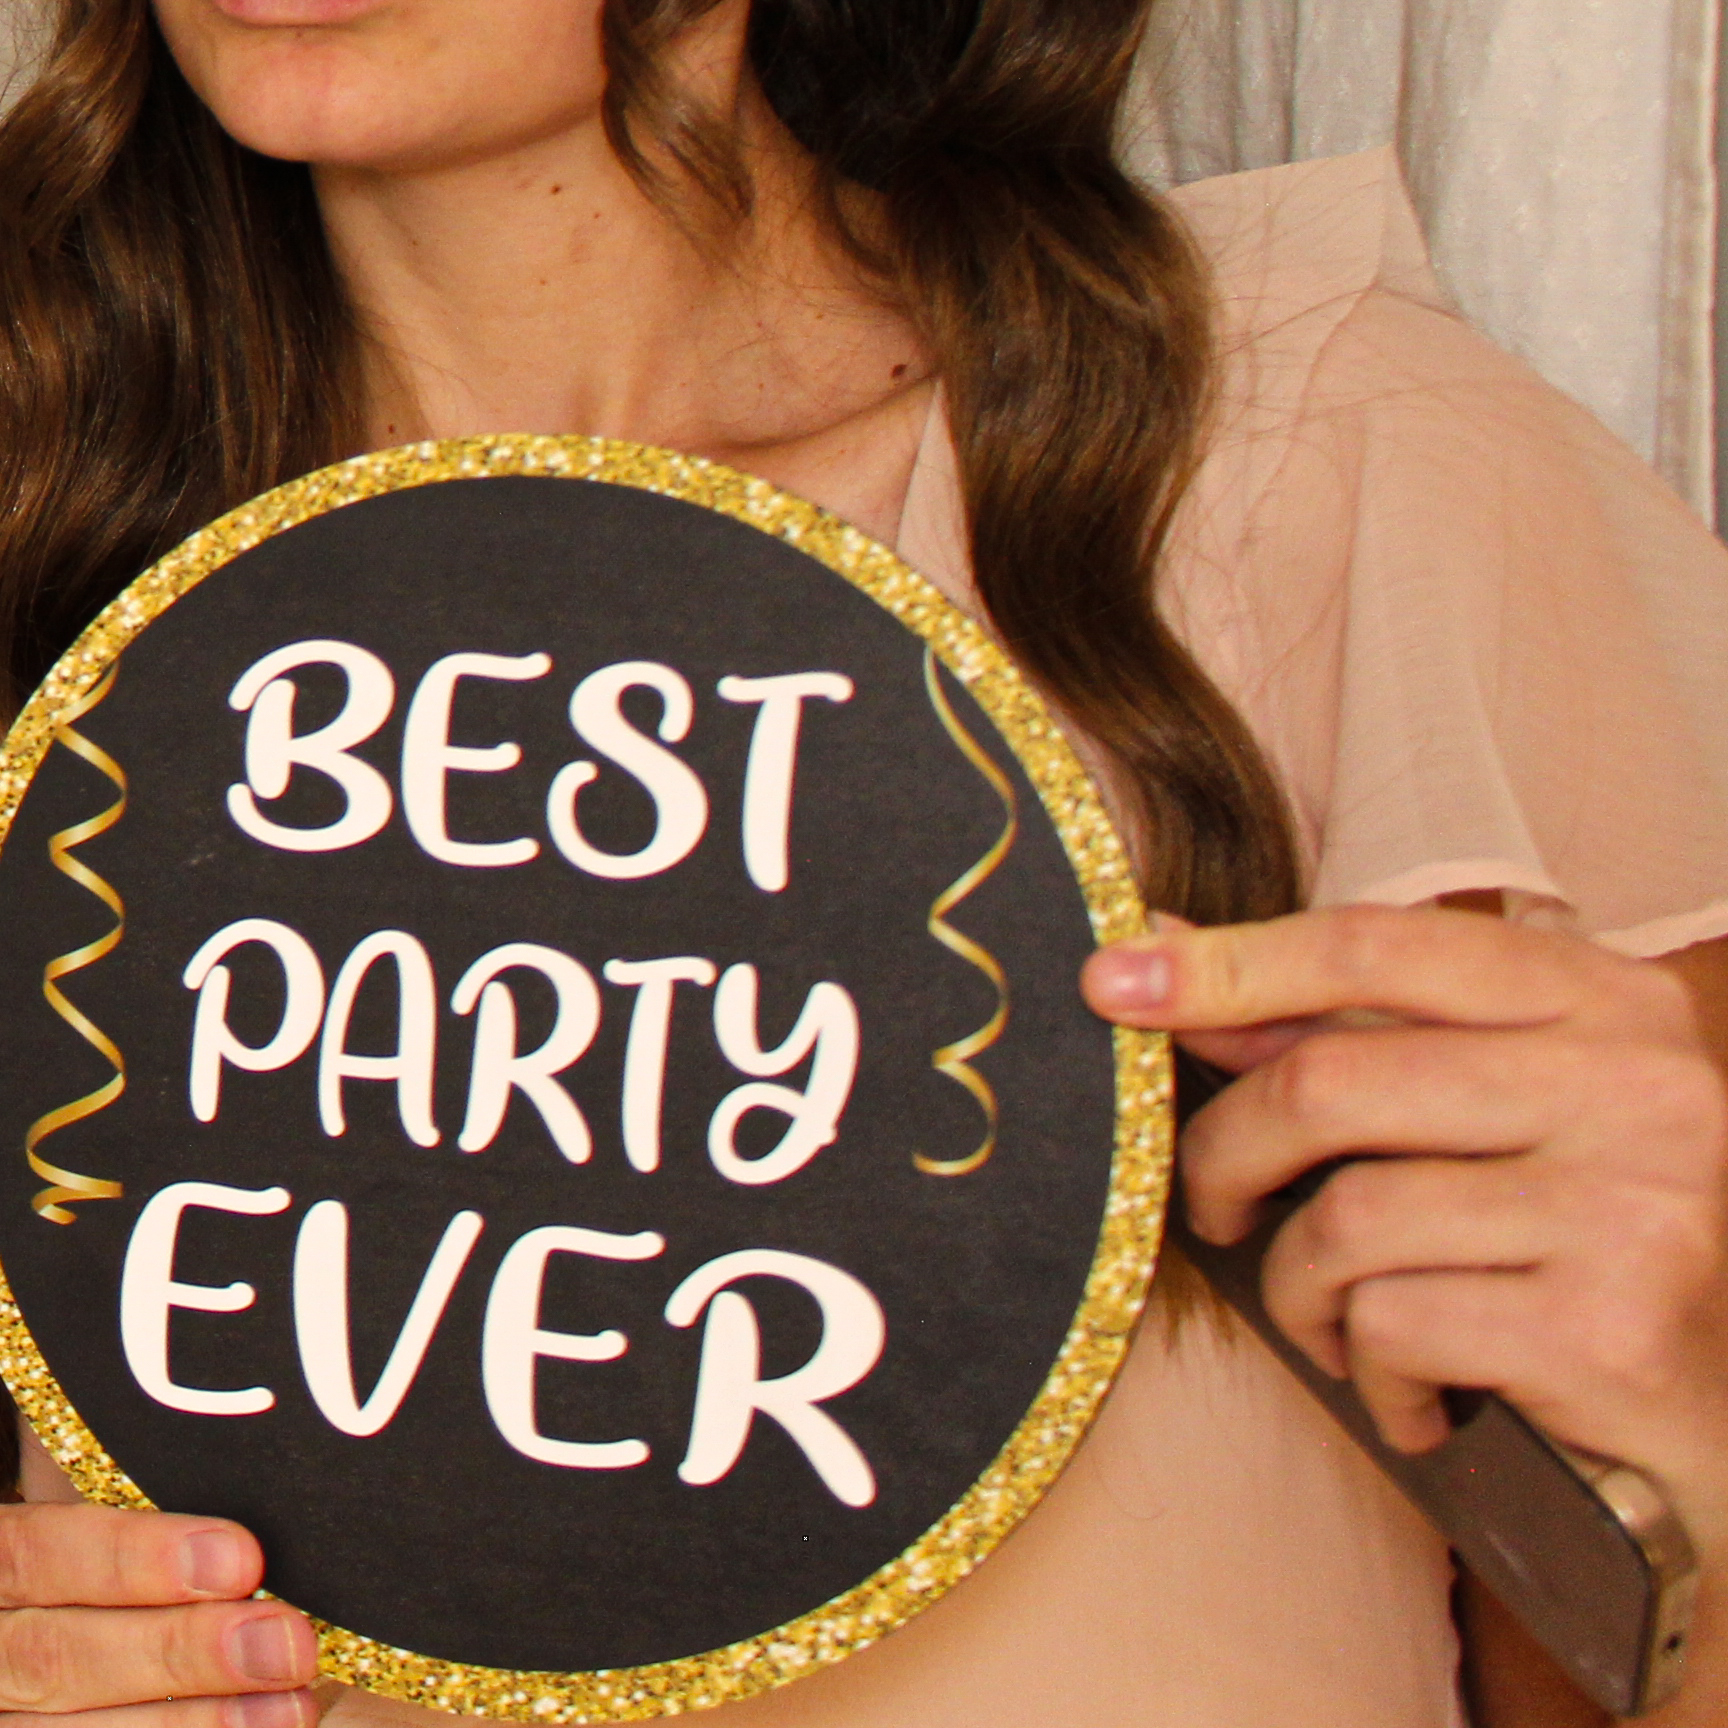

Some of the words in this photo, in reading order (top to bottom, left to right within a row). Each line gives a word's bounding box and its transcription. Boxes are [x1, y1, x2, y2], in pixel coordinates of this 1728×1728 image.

[227, 639, 854, 891] BEST
[184, 919, 860, 1185] PARTY
[120, 1182, 886, 1507] EVER
